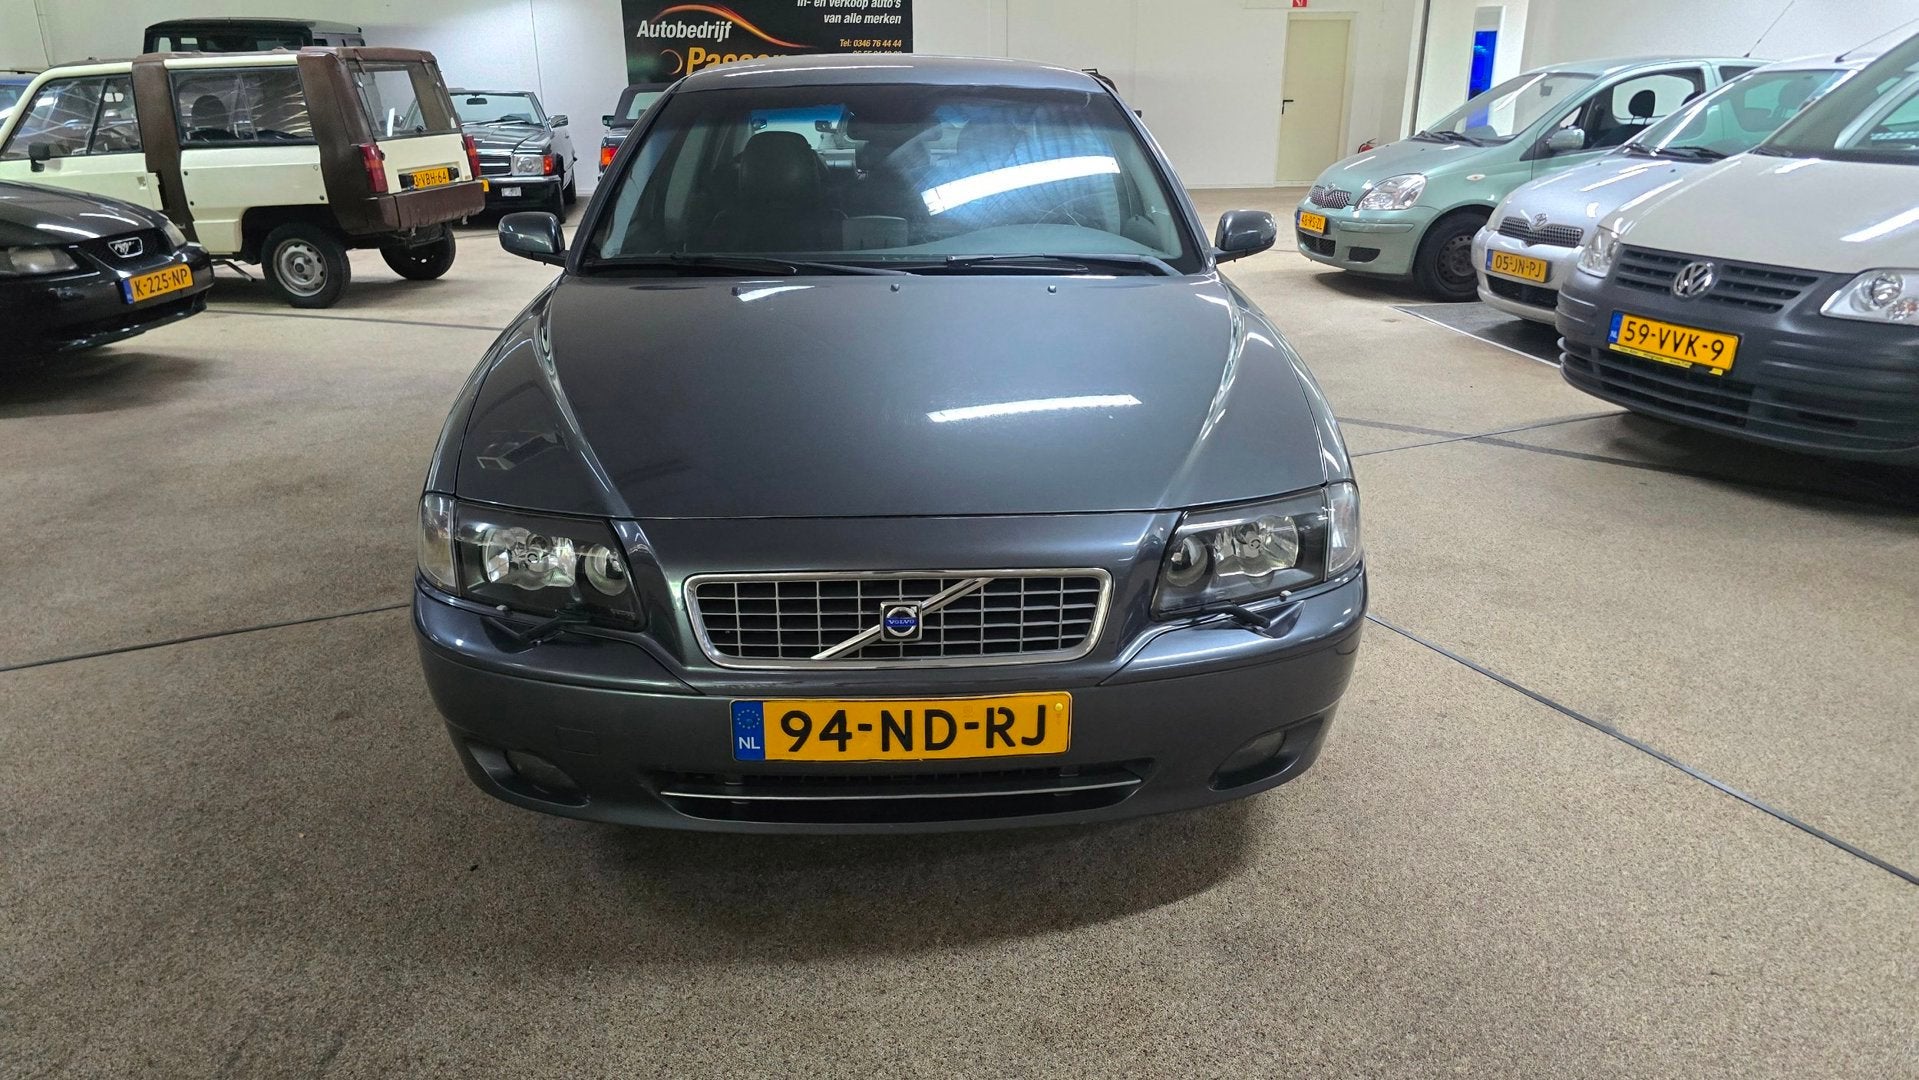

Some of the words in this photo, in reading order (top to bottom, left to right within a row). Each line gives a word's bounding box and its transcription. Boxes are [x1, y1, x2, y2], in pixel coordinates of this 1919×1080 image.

[814, 0, 826, 8] en
[829, 0, 868, 9] verkoop
[824, 14, 841, 23] van
[844, 13, 862, 24] alle
[864, 13, 901, 24] merken
[637, 20, 732, 42] Autobedrijf
[840, 39, 852, 47] Tel:
[853, 39, 871, 47] 0346
[1495, 254, 1542, 278] 05-JN-PJ
[134, 268, 188, 298] K-225-NP
[1624, 320, 1725, 361] 59-VVK-9
[780, 704, 1046, 752] 94-ND-RJ
[738, 736, 761, 750] NL
